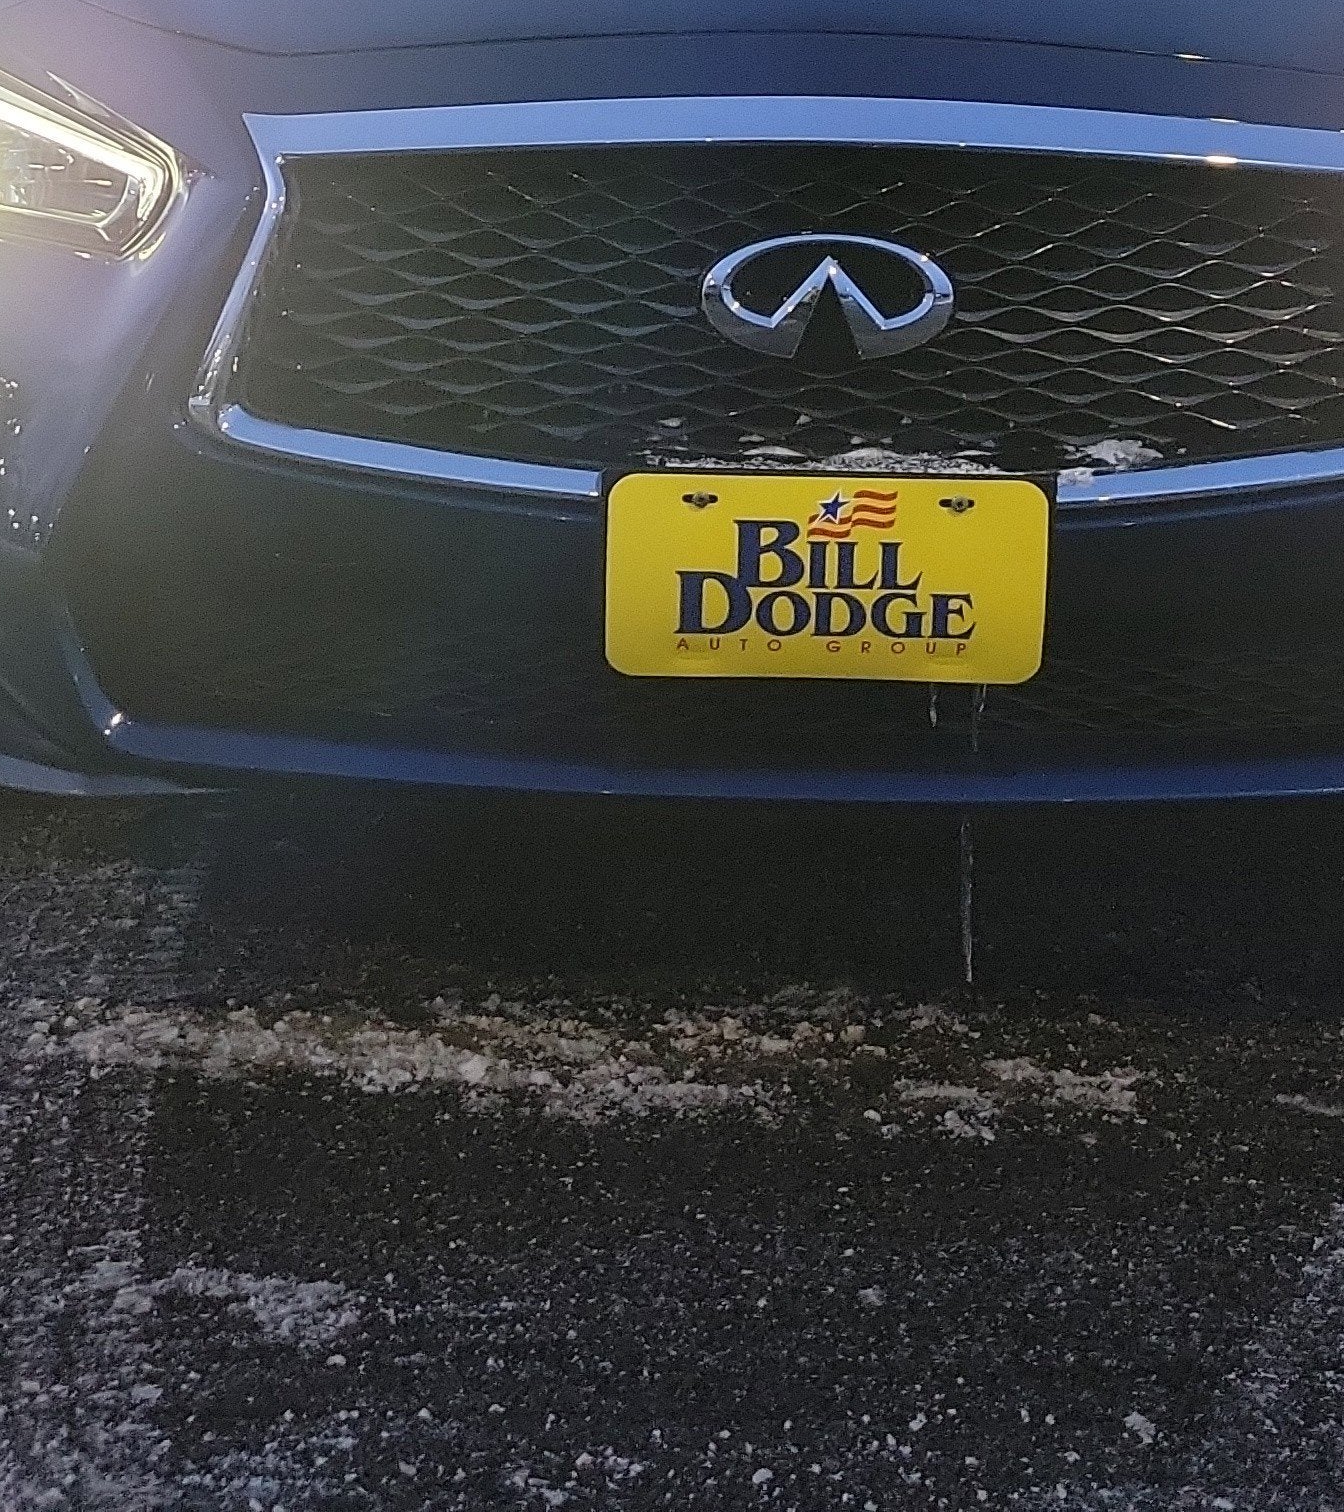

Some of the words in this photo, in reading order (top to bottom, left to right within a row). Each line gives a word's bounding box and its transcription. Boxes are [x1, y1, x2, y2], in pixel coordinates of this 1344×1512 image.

[734, 519, 923, 591] BILL
[674, 570, 977, 639] DODGE
[676, 638, 783, 653] AUTO
[826, 640, 970, 656] GROUP
